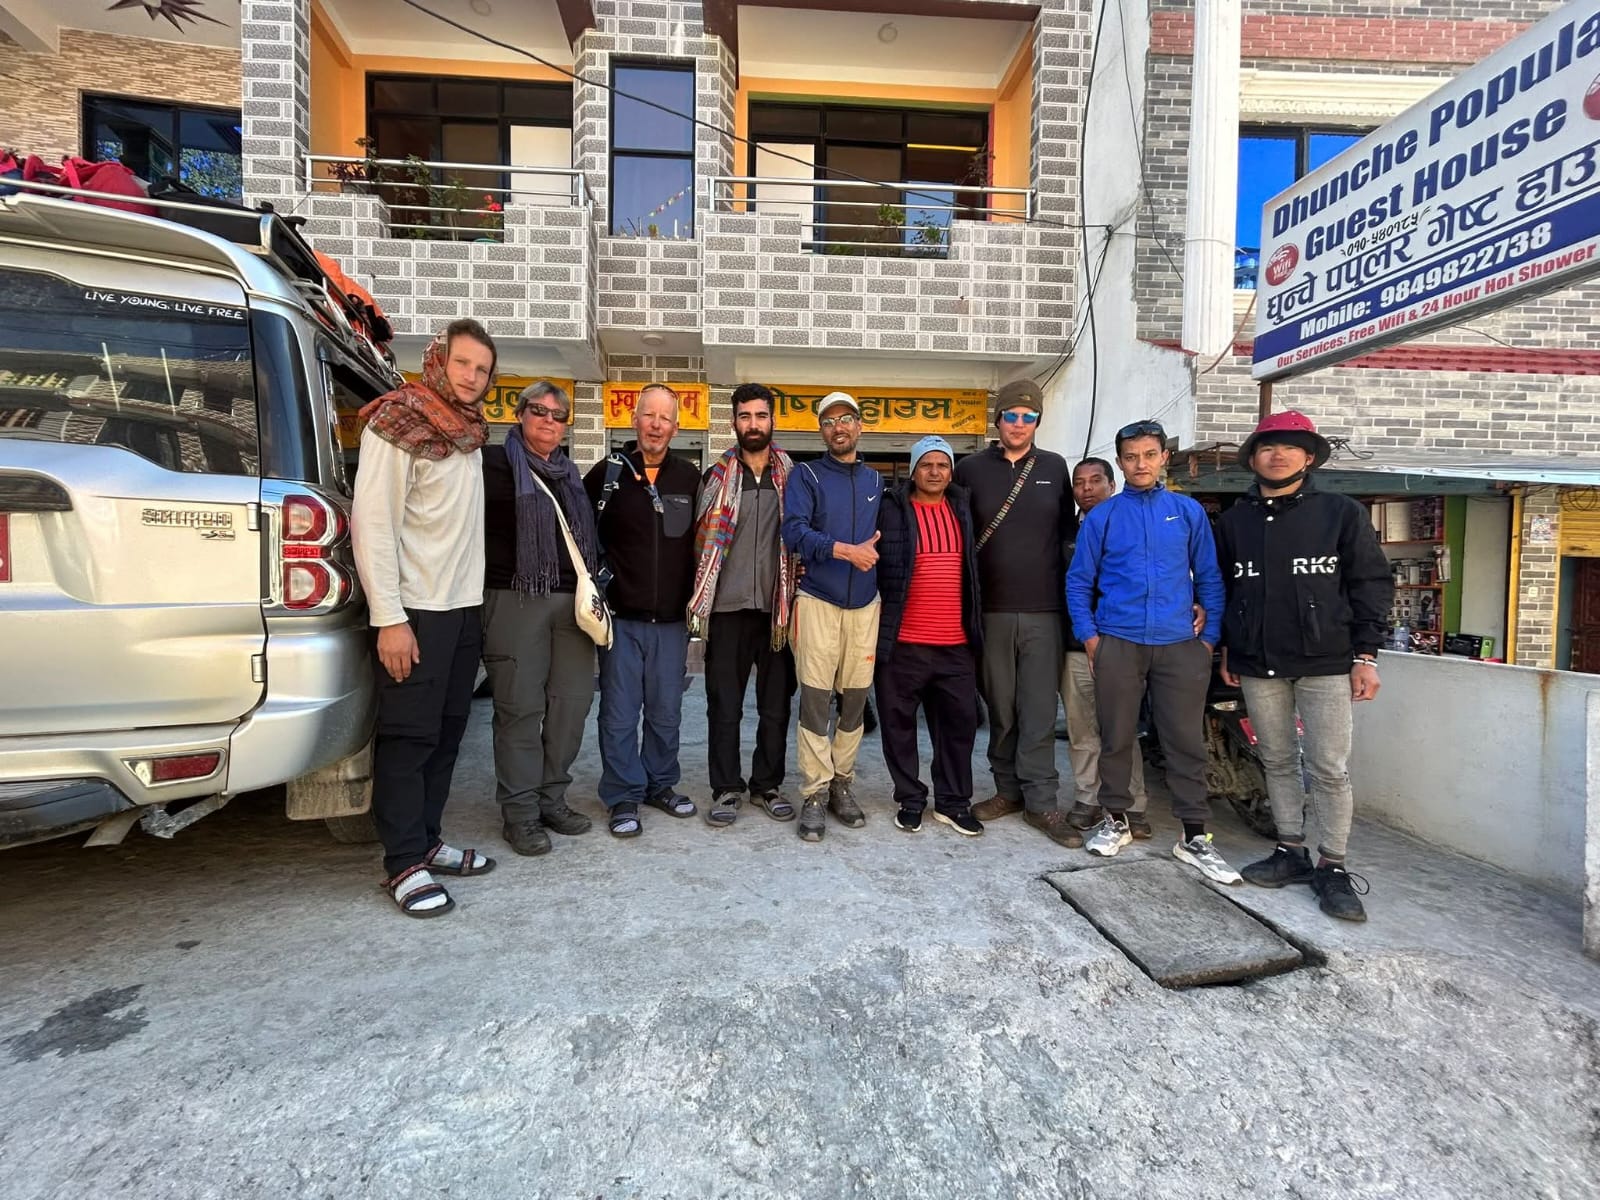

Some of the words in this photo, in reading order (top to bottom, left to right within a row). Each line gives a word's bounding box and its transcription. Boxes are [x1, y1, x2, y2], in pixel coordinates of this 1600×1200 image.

[1272, 129, 1418, 238] Dhunche
[1429, 11, 1600, 147] Popula
[1305, 185, 1404, 261] Guest
[1412, 99, 1567, 207] House
[1516, 140, 1600, 211] हाउ
[85, 291, 116, 302] LIVE
[174, 303, 204, 314] LIVE
[208, 307, 243, 319] FREE
[1277, 353, 1294, 368] Our
[1296, 336, 1346, 361] Services:
[1348, 324, 1376, 343] Free
[1378, 311, 1406, 332] Wifi
[1408, 309, 1418, 321] &
[1421, 299, 1439, 317] 24
[1443, 286, 1482, 309] Hour
[1485, 272, 1514, 295] Hot
[1518, 243, 1597, 282] Shower
[1300, 301, 1371, 340] Mobile:
[1380, 221, 1552, 308] 9849822738
